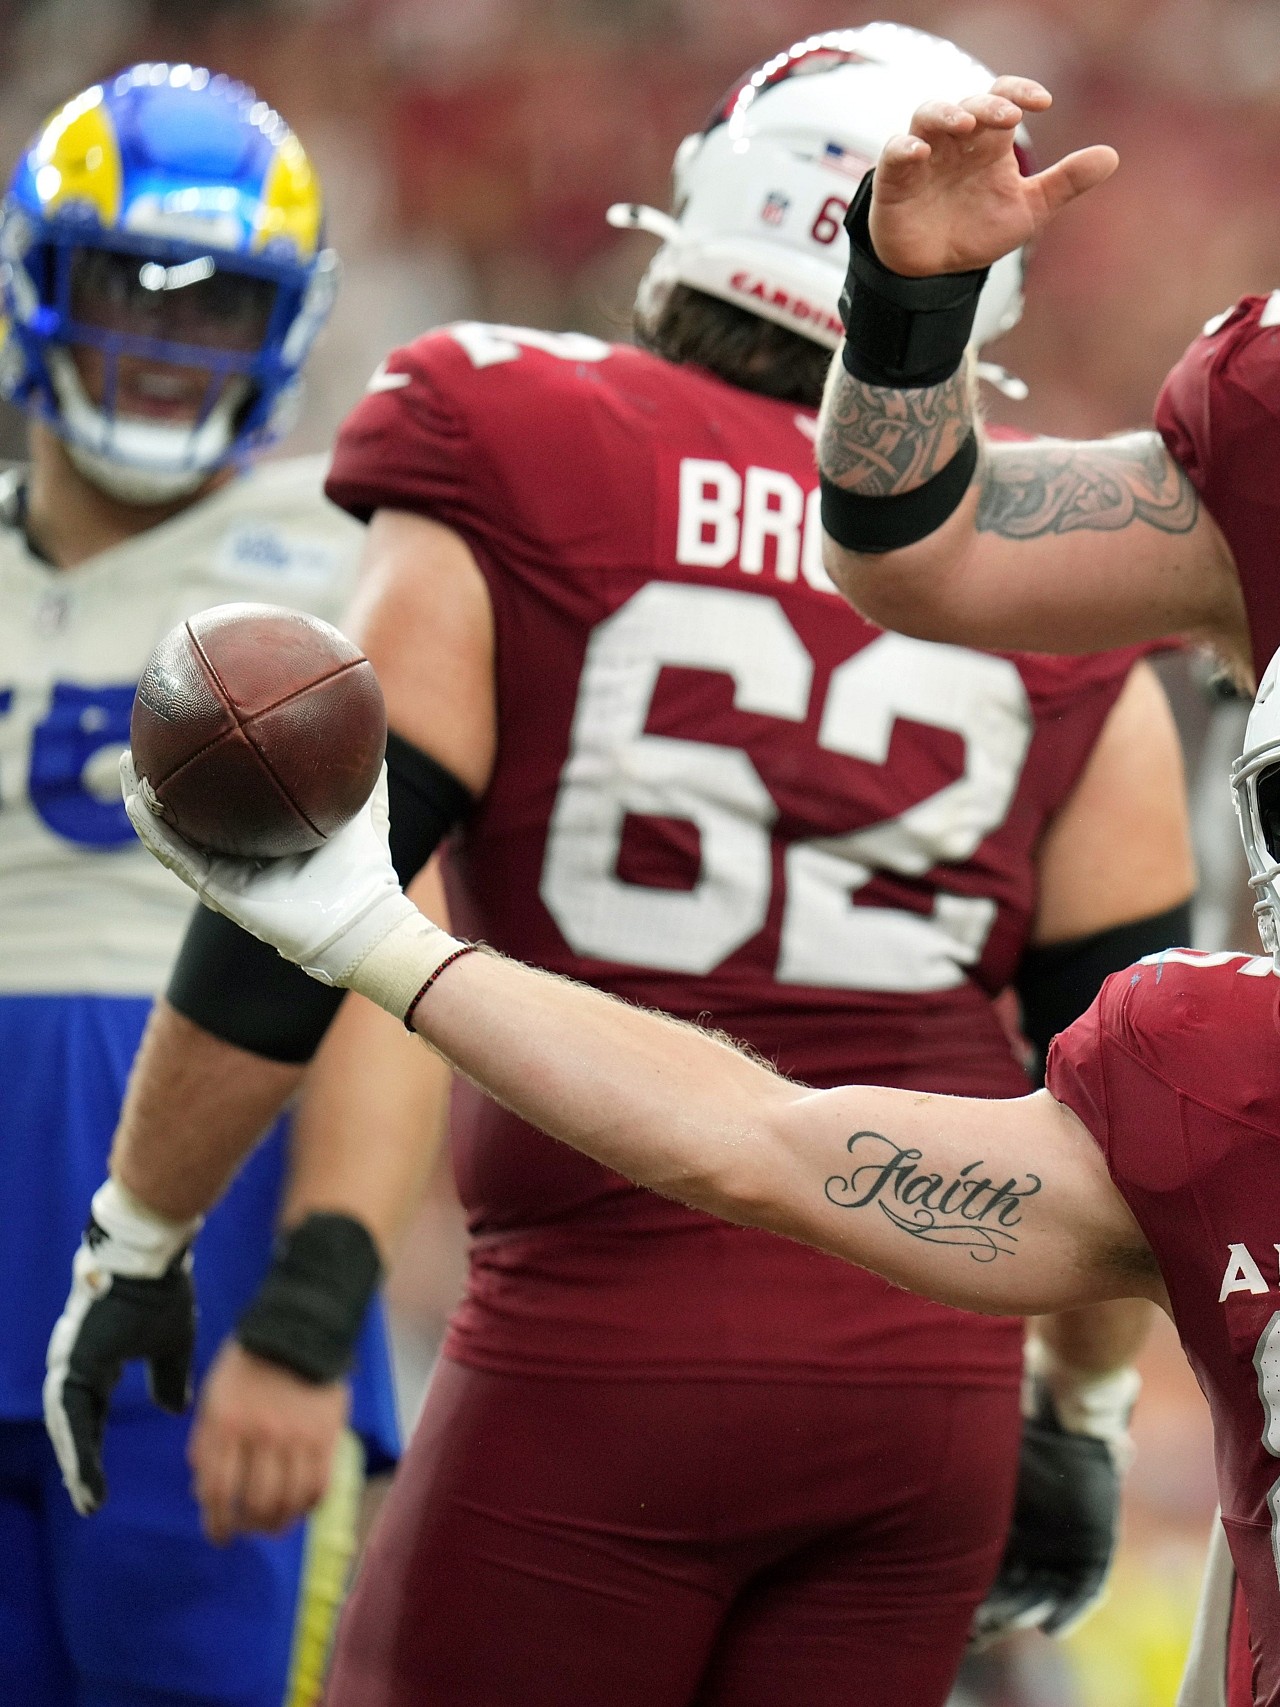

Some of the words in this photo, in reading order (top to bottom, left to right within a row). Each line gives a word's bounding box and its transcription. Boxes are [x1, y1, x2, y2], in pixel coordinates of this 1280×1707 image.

[811, 196, 850, 245] 6
[540, 580, 1034, 992] 62
[825, 1131, 1042, 1228] Faith
